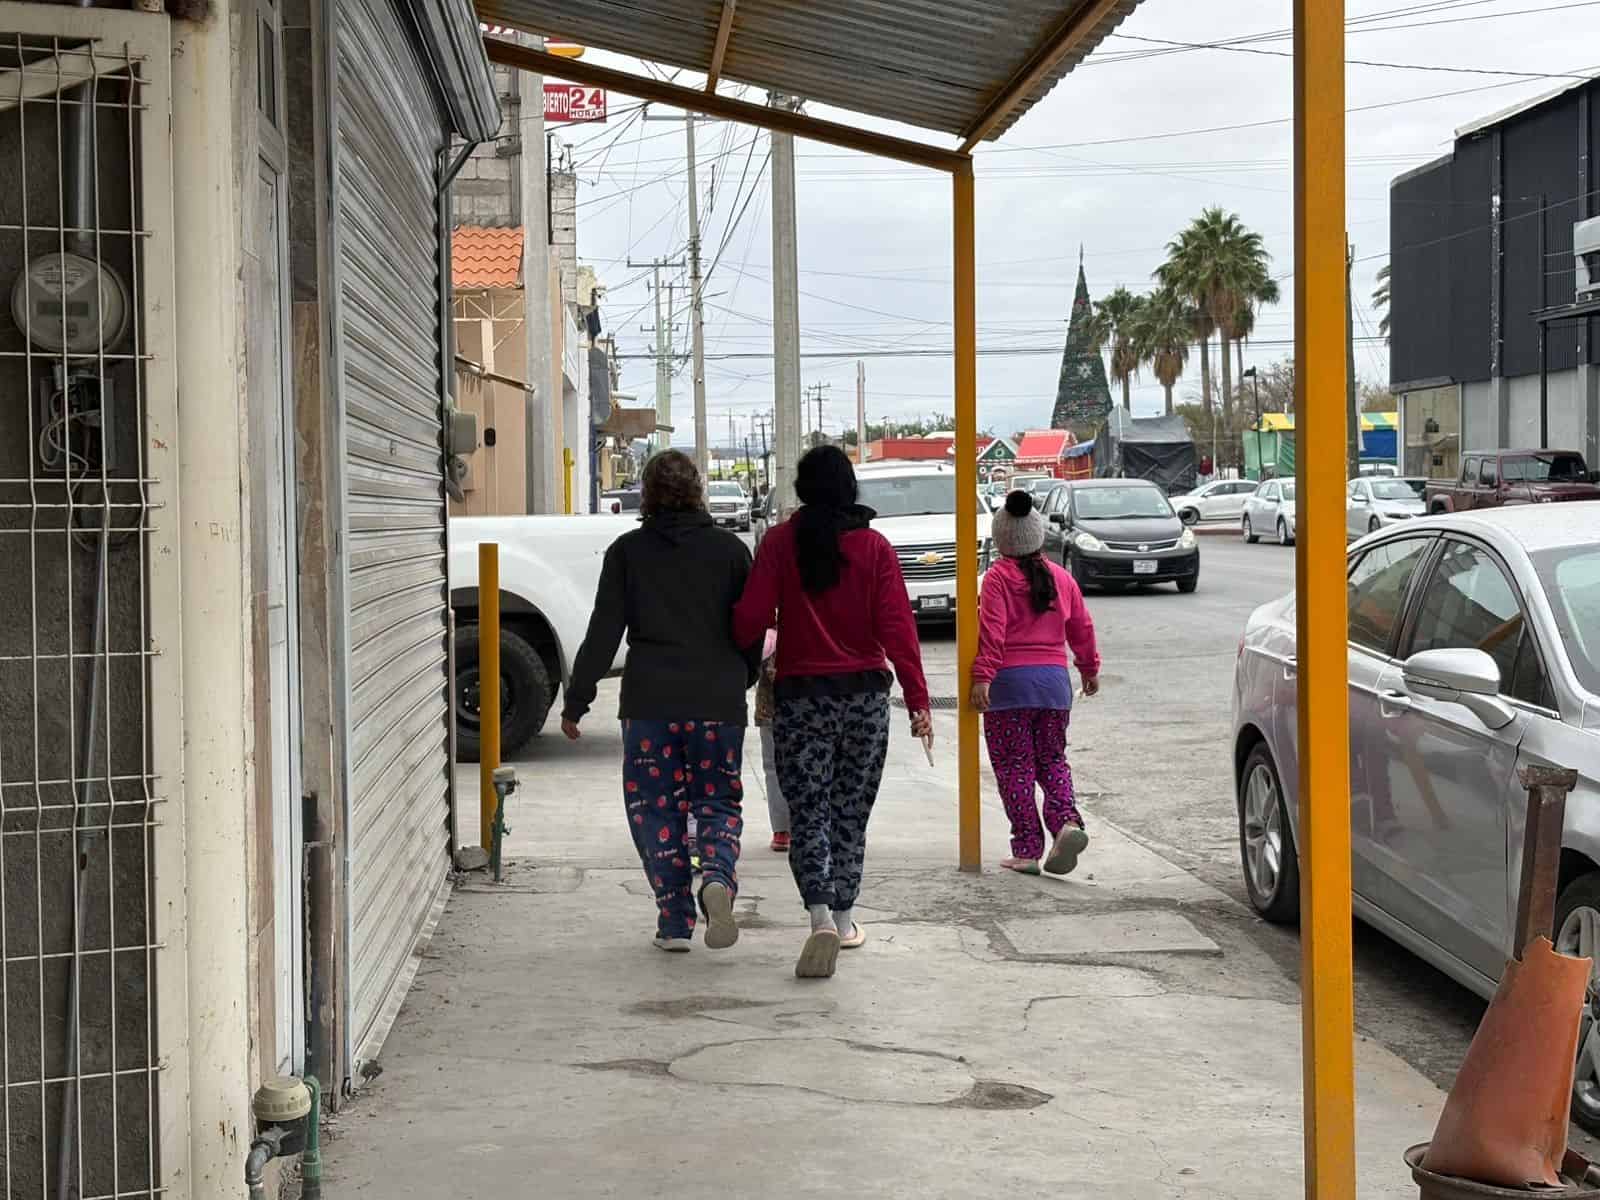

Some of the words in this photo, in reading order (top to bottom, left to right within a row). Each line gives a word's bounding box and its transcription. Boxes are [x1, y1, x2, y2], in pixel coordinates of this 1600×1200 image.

[543, 91, 569, 113] BIERTO
[571, 88, 603, 109] 24
[571, 109, 603, 118] HORAS
